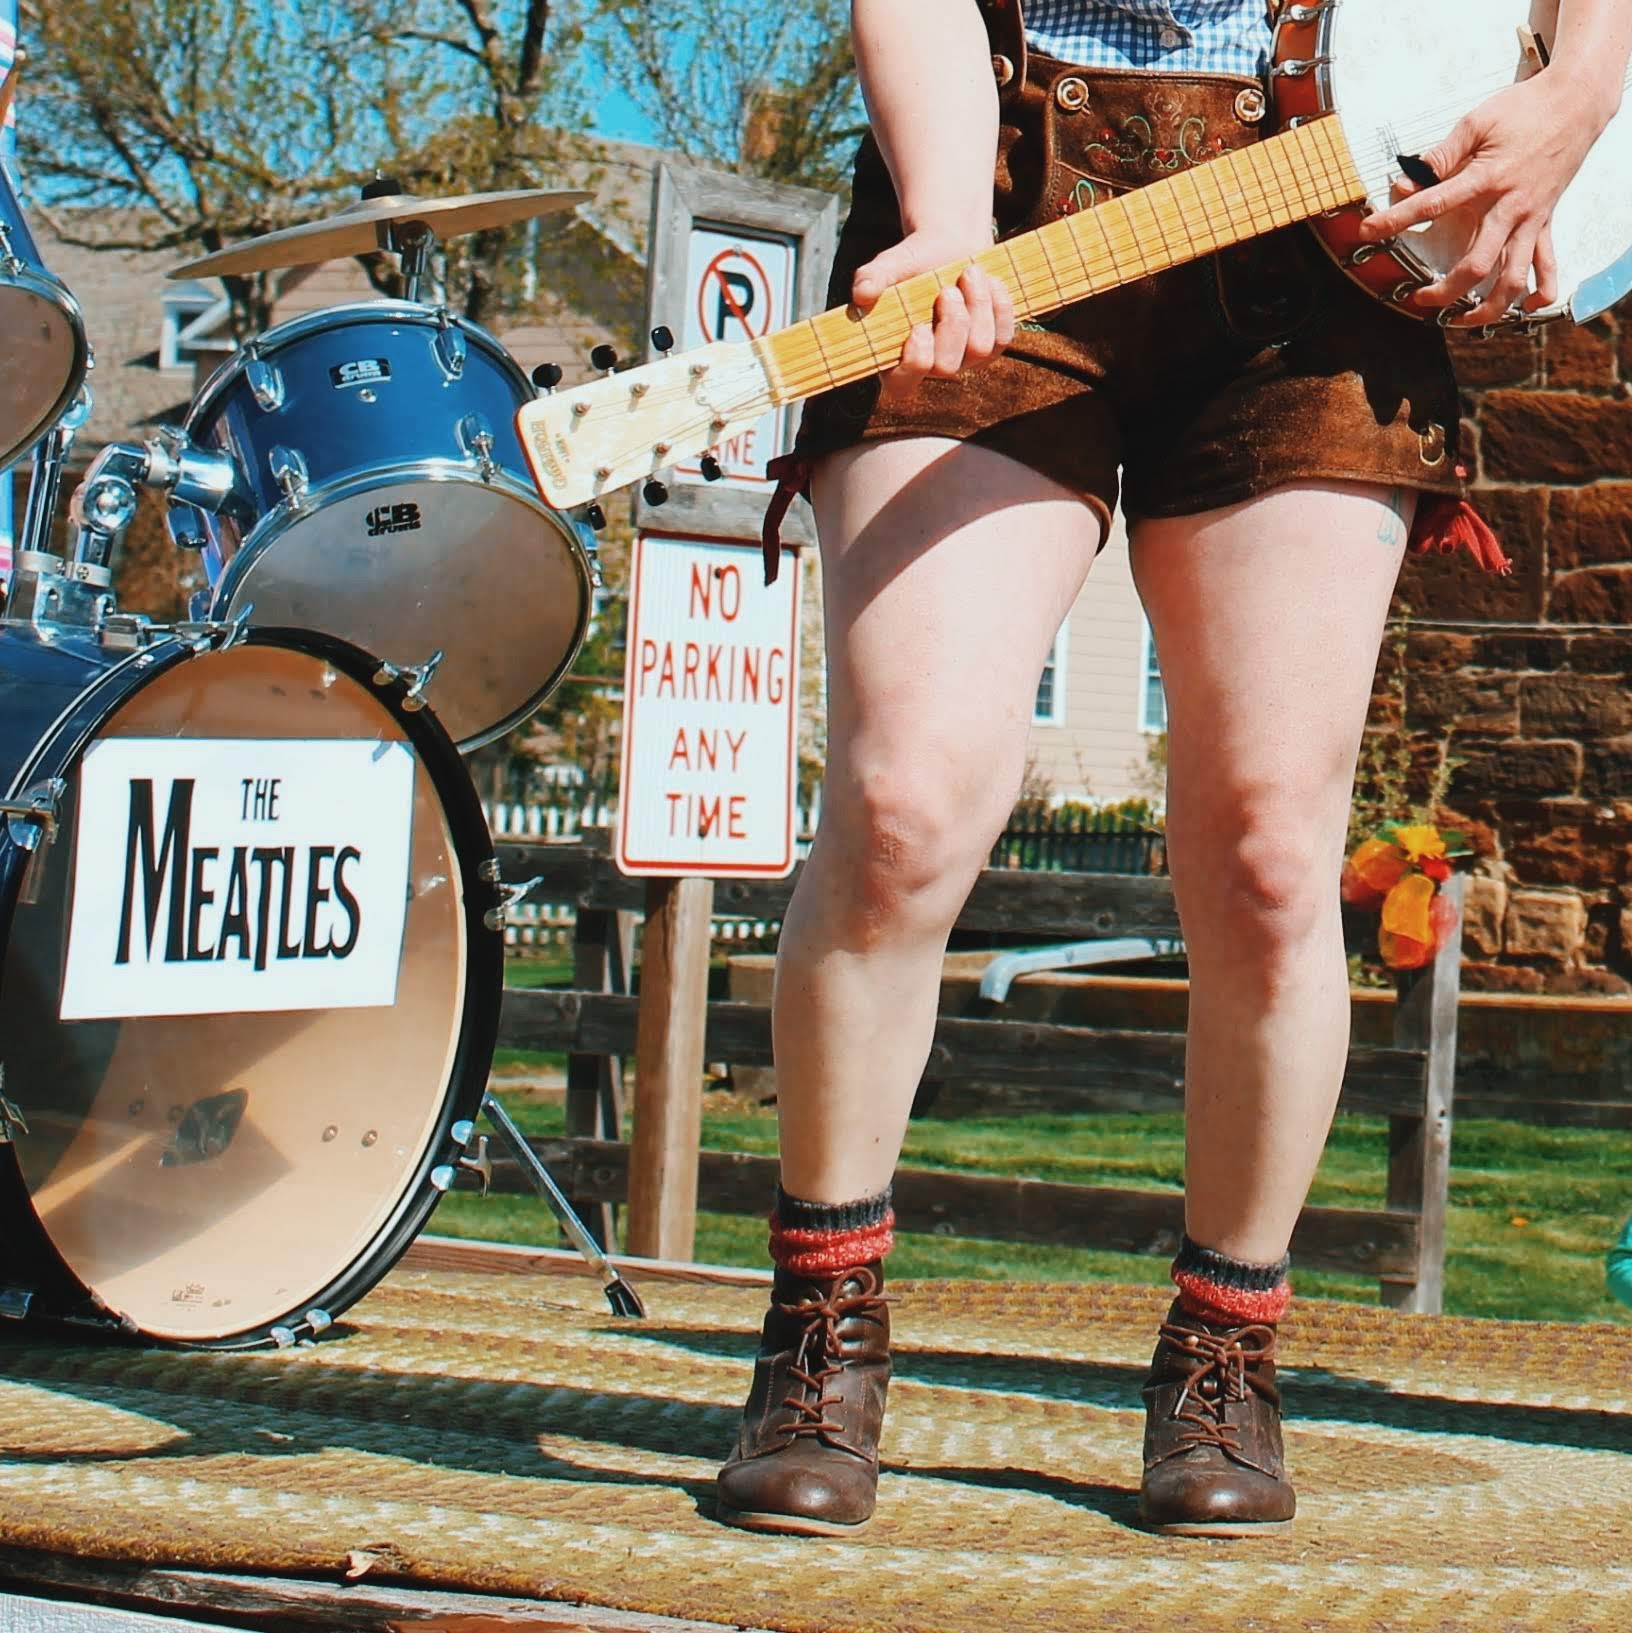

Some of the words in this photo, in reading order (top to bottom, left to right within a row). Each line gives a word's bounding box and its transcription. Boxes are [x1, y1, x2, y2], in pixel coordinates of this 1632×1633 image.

[366, 503, 421, 527] CB
[368, 520, 422, 536] drums
[689, 561, 741, 622] NO
[639, 639, 784, 705] PARKING
[668, 726, 747, 773] ANY
[241, 778, 282, 821] THE
[665, 793, 747, 840] TIME
[114, 778, 362, 972] MEATLES
